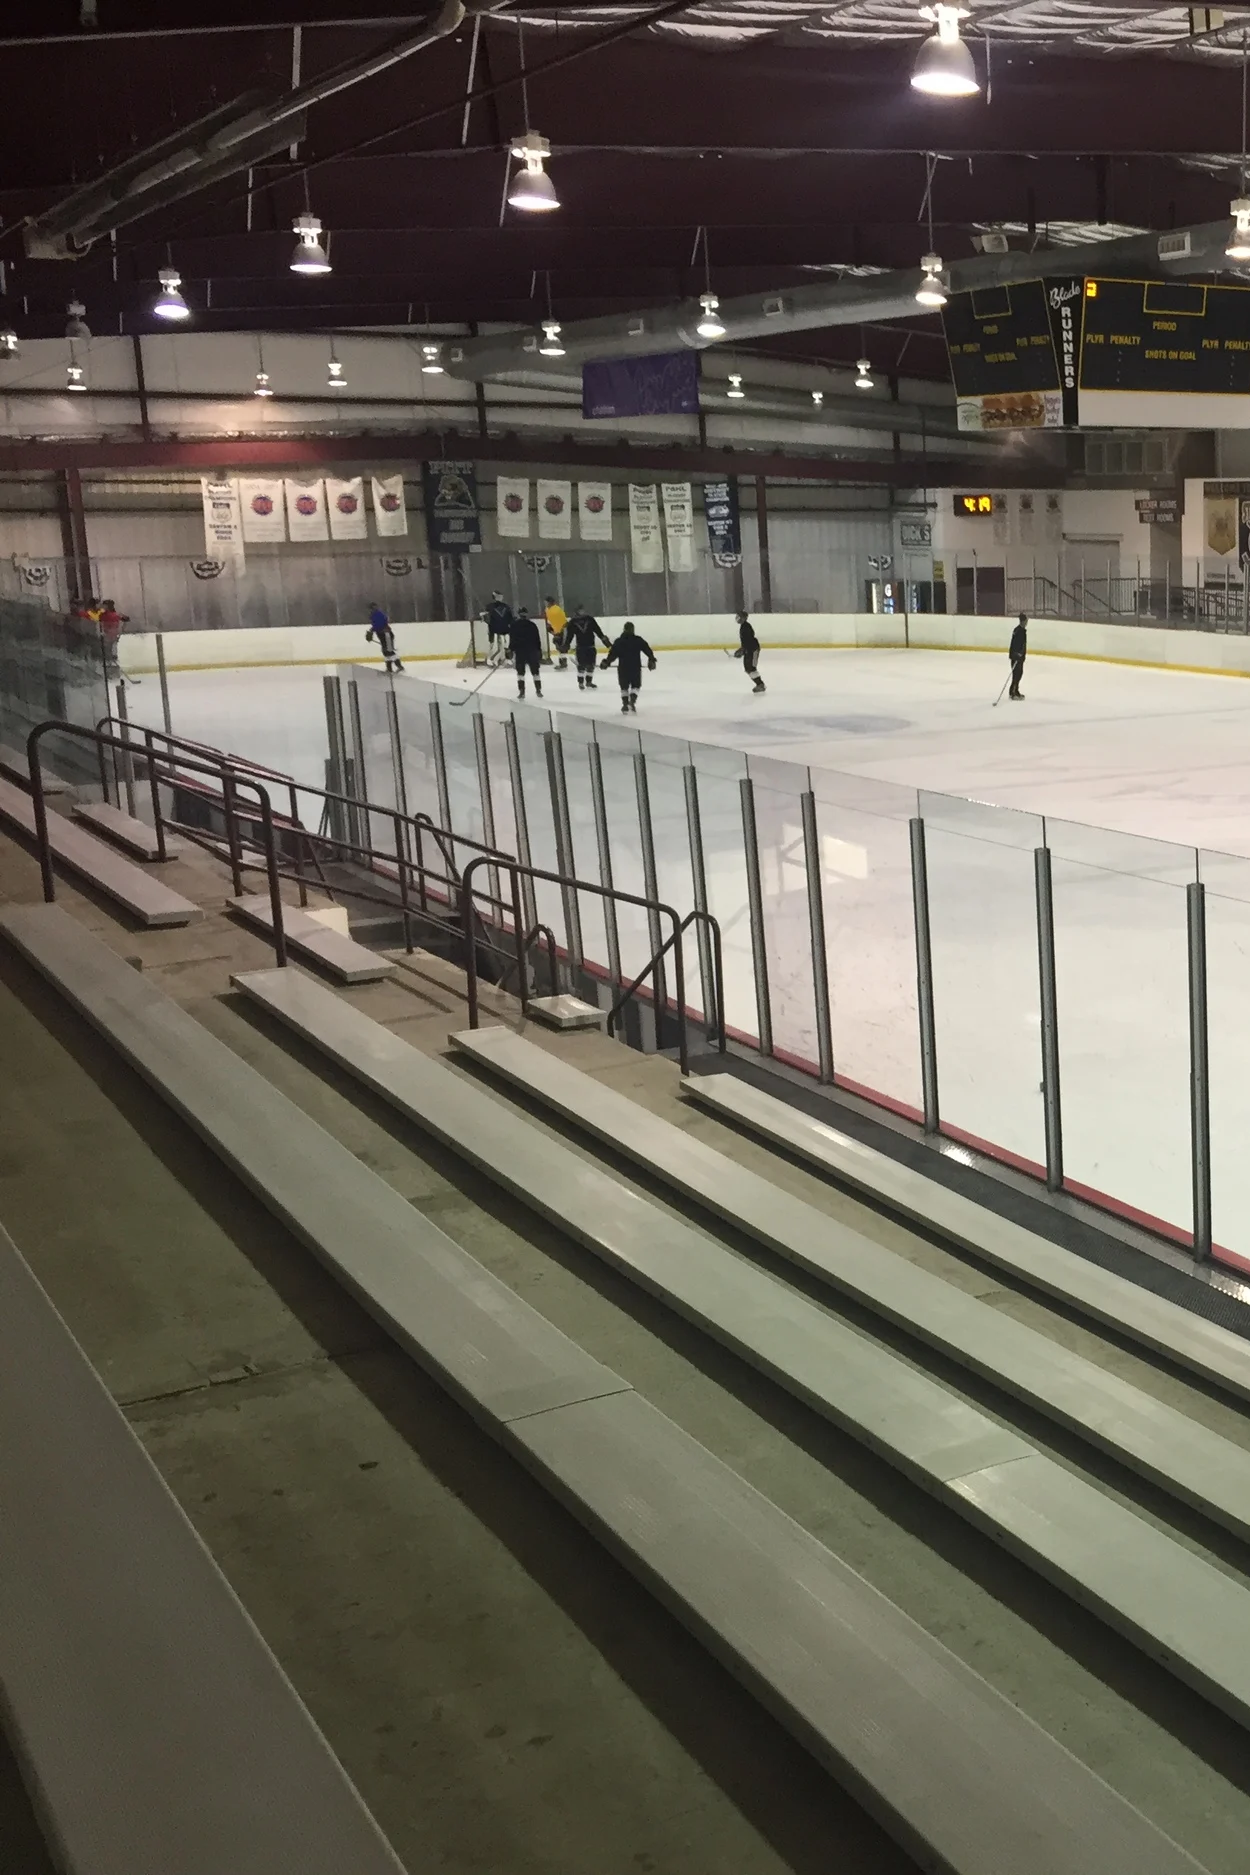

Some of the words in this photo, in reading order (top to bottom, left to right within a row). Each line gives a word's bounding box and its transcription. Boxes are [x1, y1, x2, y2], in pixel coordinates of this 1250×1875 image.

[1050, 280, 1082, 309] Blade
[1152, 321, 1177, 331] PERIOD
[1086, 334, 1104, 344] PLYR
[1110, 335, 1141, 345] PENALTY
[1202, 339, 1219, 349] PLYR
[1061, 306, 1076, 388] RUNNERS
[1145, 350, 1167, 360] SHOTS
[1168, 351, 1178, 360] ON
[1179, 351, 1197, 361] GOAL
[963, 496, 991, 512] 4:19
